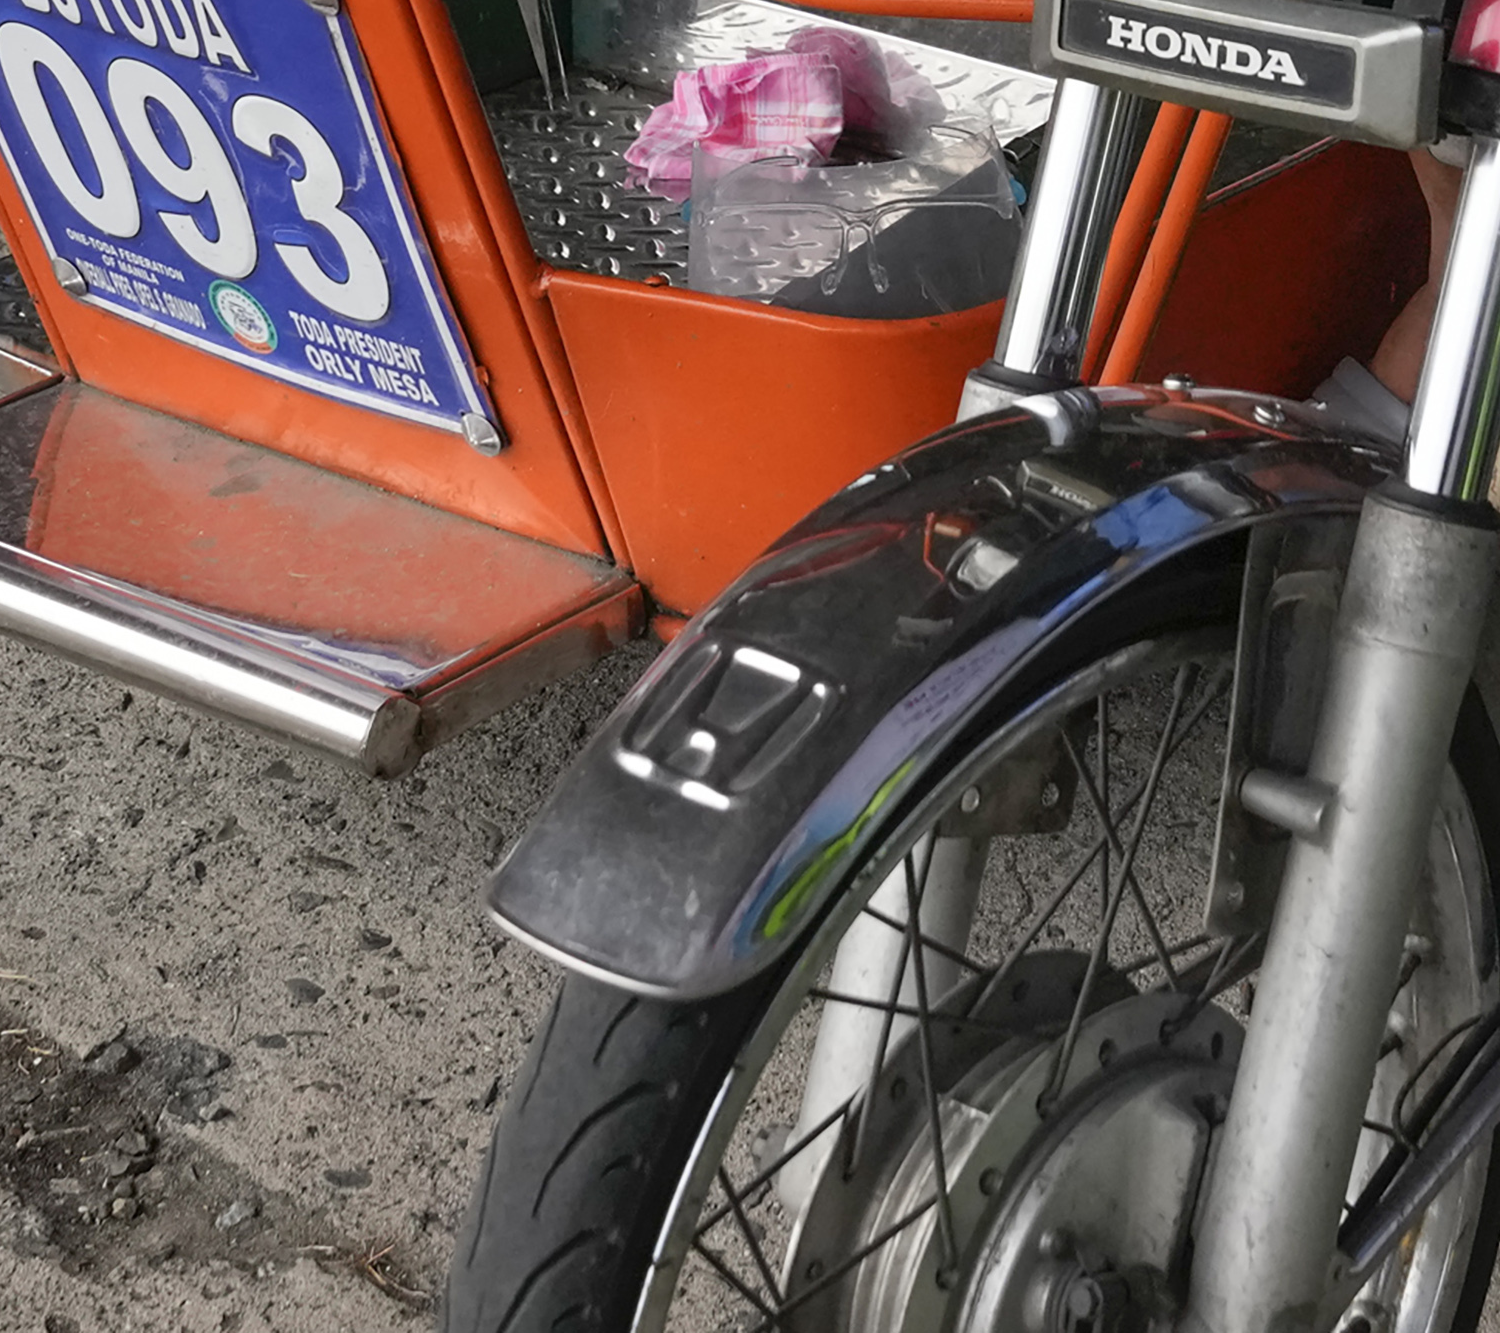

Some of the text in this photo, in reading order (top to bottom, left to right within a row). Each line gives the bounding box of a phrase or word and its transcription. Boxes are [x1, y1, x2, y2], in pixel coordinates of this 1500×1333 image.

[1106, 15, 1307, 86] HONDA
[66, 227, 185, 283] ONE-TODA FEDERATION
[101, 253, 160, 285] OF MANILA
[288, 310, 338, 349] TODA
[333, 324, 426, 375] PRESIDENT
[304, 344, 441, 407] ORLY MESA
